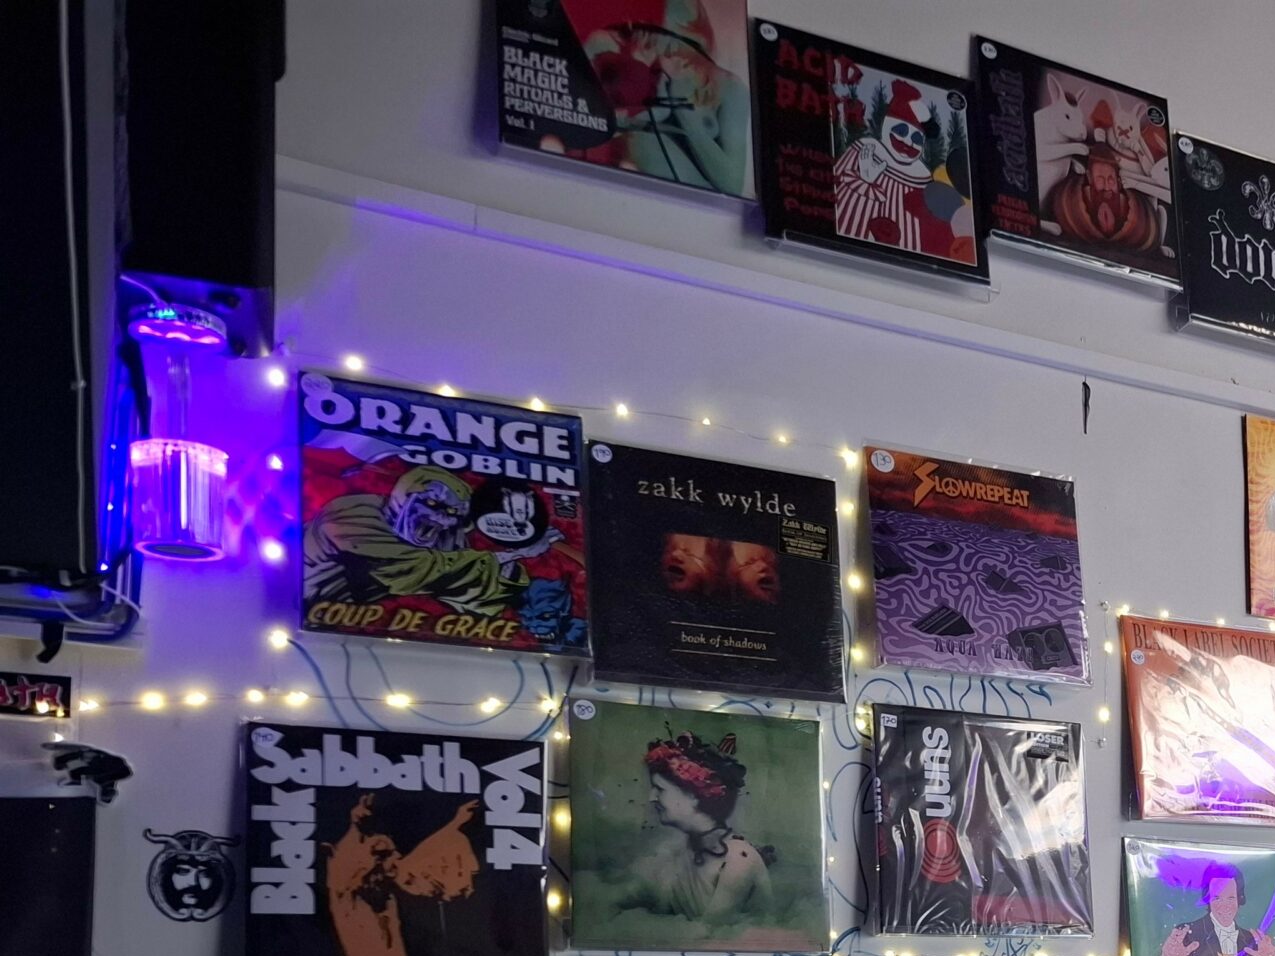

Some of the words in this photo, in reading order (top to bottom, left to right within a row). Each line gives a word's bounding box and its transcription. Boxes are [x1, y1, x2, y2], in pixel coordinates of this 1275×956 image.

[503, 45, 569, 81] BLACK
[776, 38, 864, 85] ACID
[503, 67, 570, 99] MAGIC
[503, 83, 574, 112] RITUALS
[504, 101, 609, 133] PERVERSIONS
[506, 115, 530, 131] Vol.
[776, 79, 868, 132] BATH
[304, 390, 574, 460] ORANGE
[402, 445, 576, 486] GOBLIN
[913, 460, 1031, 509] SLOWREPEAT
[638, 477, 703, 504] zakk
[717, 491, 798, 517] wylde
[308, 601, 381, 629] COUP
[390, 607, 425, 631] DE
[434, 611, 520, 640] GRACE
[681, 631, 706, 646] book
[708, 633, 722, 648] of
[723, 635, 768, 651] shadows
[934, 639, 977, 656] AQUA
[1030, 732, 1065, 746] LOSER
[251, 732, 482, 794] Sabbath
[921, 726, 952, 819] sunn
[250, 787, 317, 915] Black
